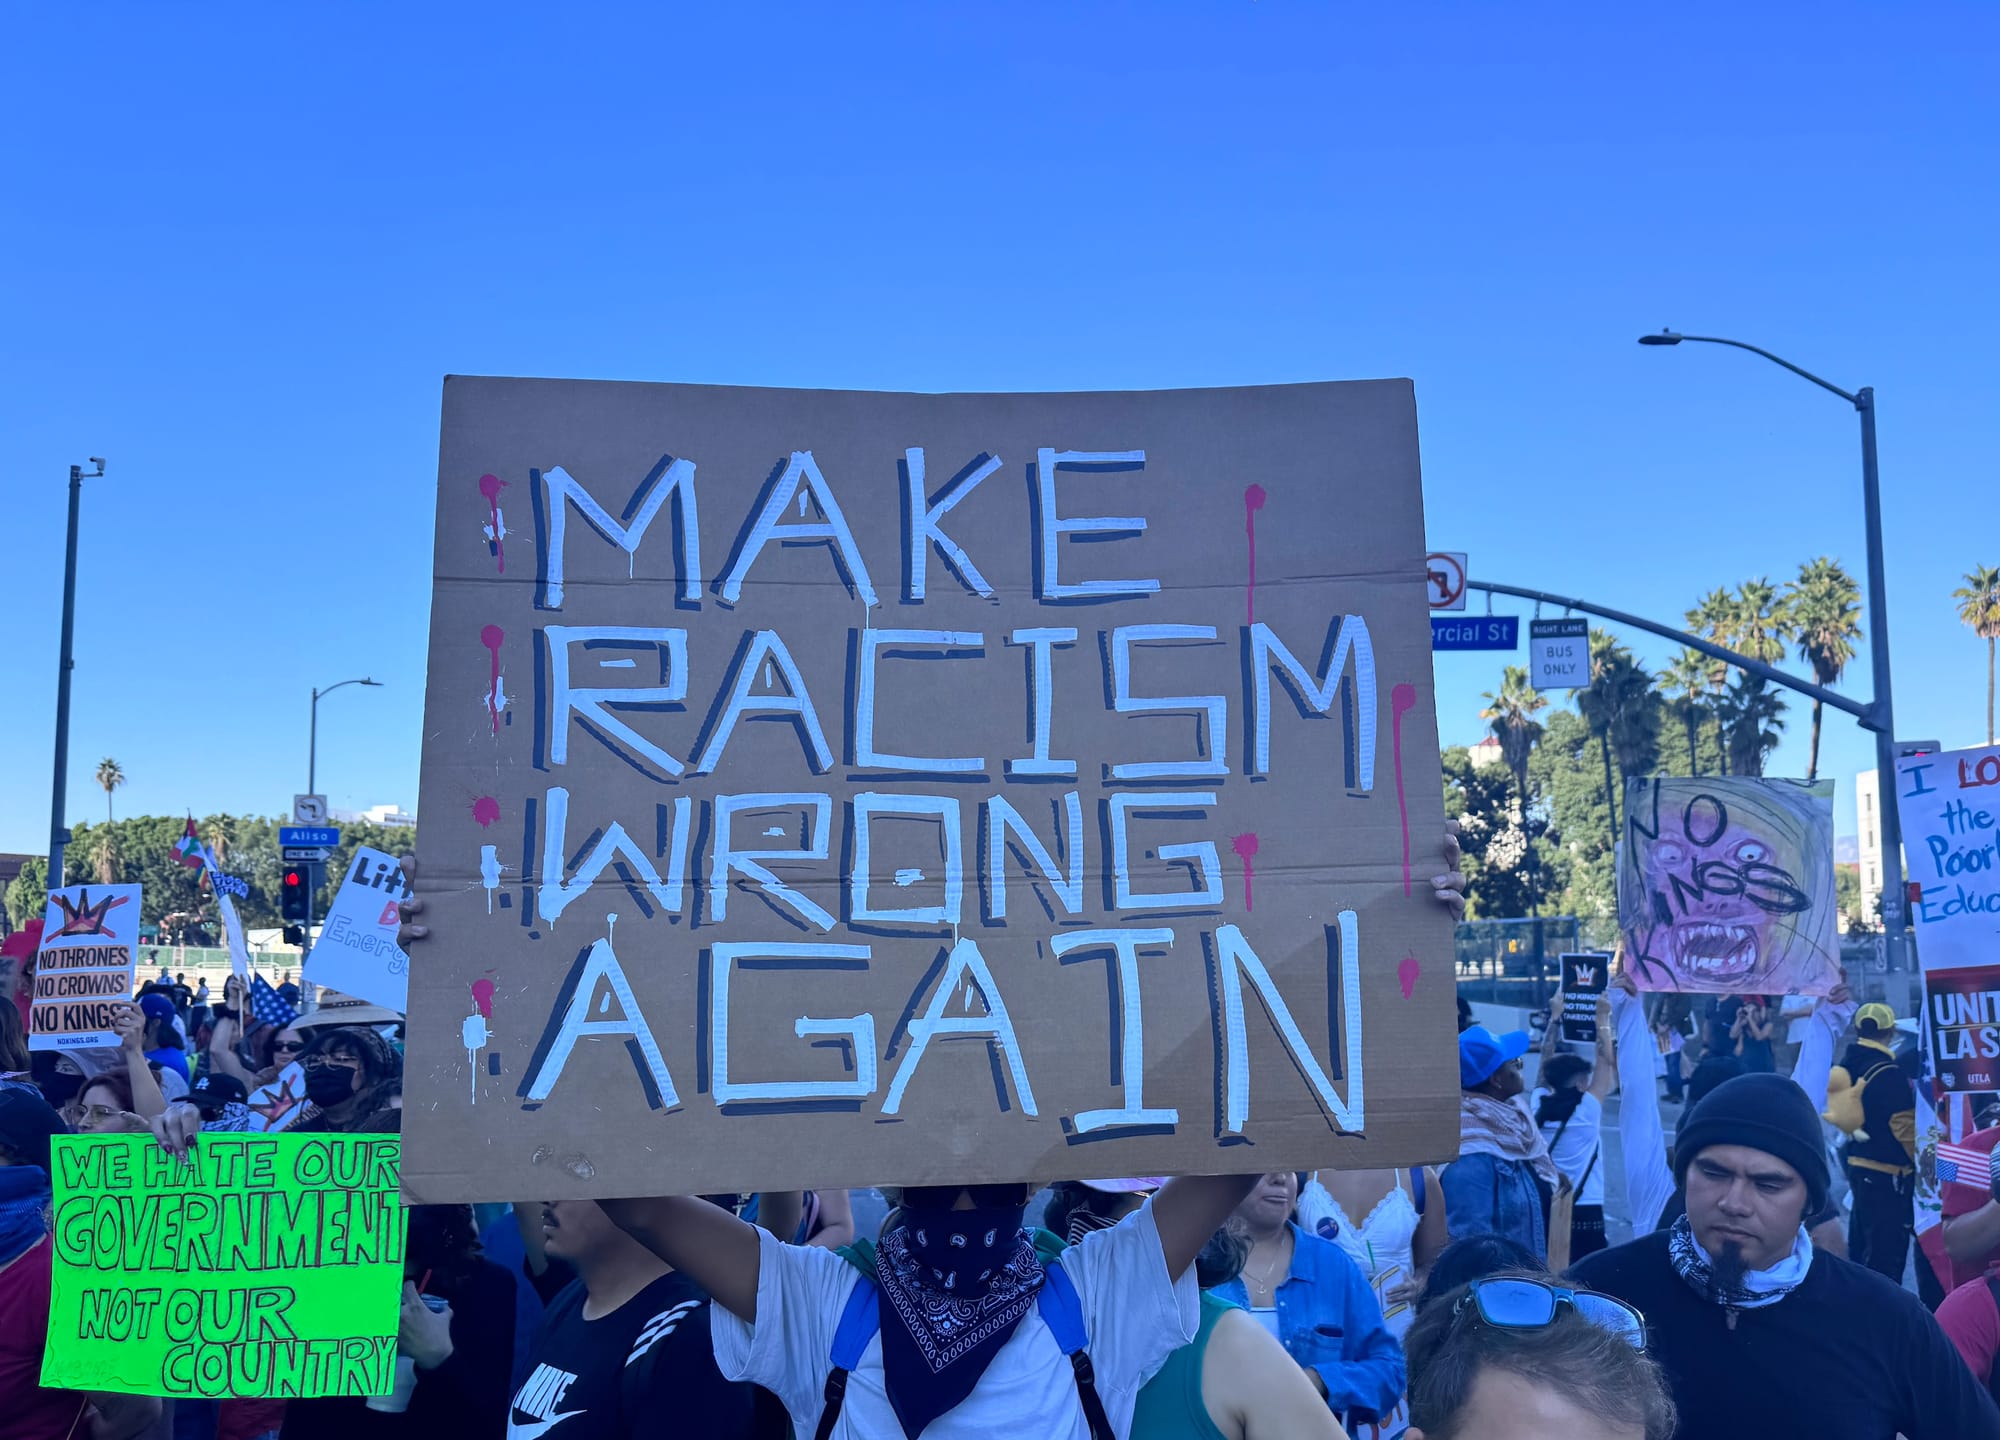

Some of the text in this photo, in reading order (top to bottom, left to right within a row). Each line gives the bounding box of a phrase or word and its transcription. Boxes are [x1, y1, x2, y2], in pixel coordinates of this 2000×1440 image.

[530, 447, 1161, 611] MAKE
[1488, 623, 1509, 641] St
[1533, 623, 1584, 633] RIGHT LANE
[1543, 663, 1576, 676] ONLY
[1546, 645, 1573, 658] BUS
[533, 614, 1378, 798] RACISM
[1901, 754, 2000, 798] I LO
[290, 831, 328, 841] Aliso
[1939, 798, 1995, 836] the
[1629, 777, 1728, 902] NO
[520, 786, 1224, 939] WRONG
[39, 947, 129, 971] NO THRONES
[326, 914, 410, 976] Energ
[35, 977, 54, 997] NO
[58, 974, 125, 996] CROWNS
[1564, 992, 1576, 1000] NO
[32, 1005, 58, 1032] NO
[515, 906, 1366, 1147] AGAIN
[56, 1036, 99, 1045] NOKINGS.ORG
[1967, 1073, 1991, 1084] UTLA
[60, 1140, 400, 1189] WE HATE OUR
[54, 1189, 406, 1273] GOVERNMENT
[79, 1285, 298, 1345] NOT OUR
[161, 1335, 398, 1398] COUNTRY
[513, 1361, 579, 1422] NIKE
